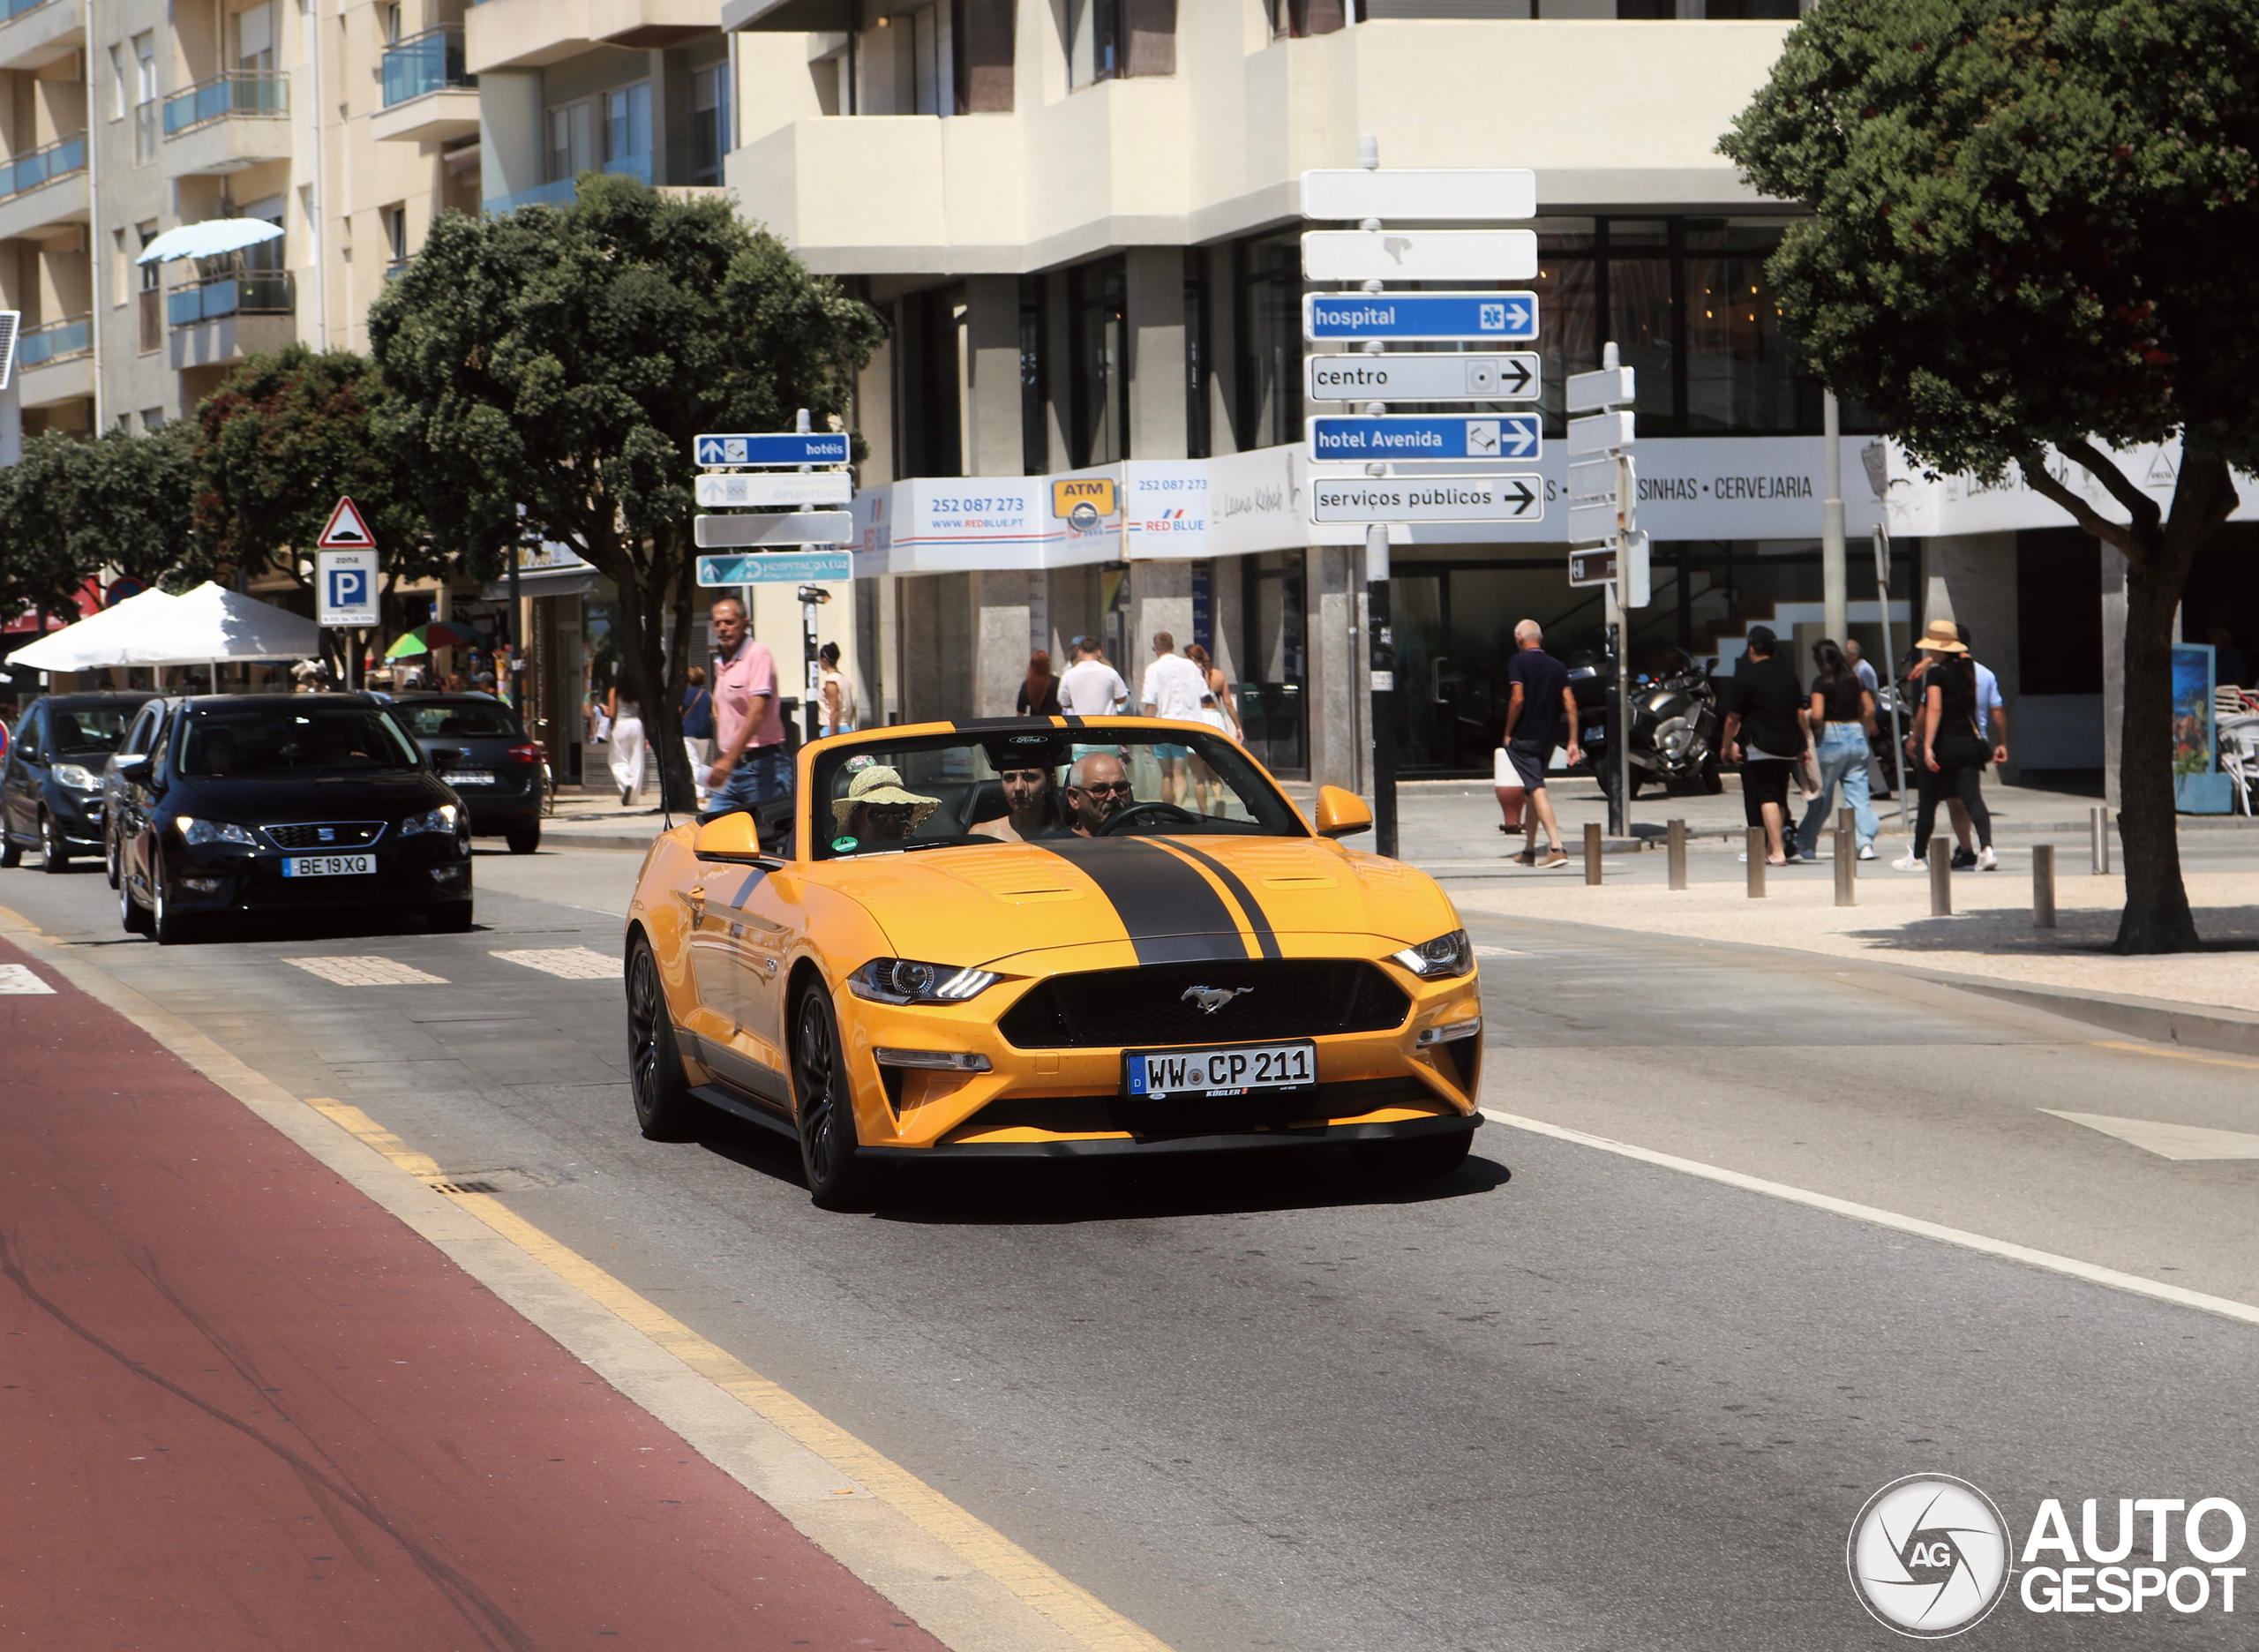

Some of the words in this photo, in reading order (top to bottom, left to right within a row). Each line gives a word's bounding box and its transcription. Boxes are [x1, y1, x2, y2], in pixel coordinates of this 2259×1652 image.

[1315, 306, 1396, 329] hospital
[1317, 368, 1388, 385] centro
[1318, 431, 1367, 447] hotel
[1371, 431, 1443, 447] Avenida
[806, 443, 844, 455] hotéis
[1064, 484, 1103, 496] ATM
[1139, 480, 1160, 490] 252
[1163, 480, 1183, 490] 087
[1188, 479, 1207, 489] 273
[1636, 477, 1697, 500] SINHAS
[1715, 477, 1812, 499] CERVEJARIA
[773, 487, 845, 500] desportivos
[1320, 490, 1401, 510] serviços
[1409, 488, 1491, 508] públicos
[932, 499, 959, 512] 252
[963, 499, 992, 512] 087
[997, 498, 1024, 511] 273
[932, 519, 1024, 528] WWW.REDBLUE.PT
[1146, 521, 1170, 531] RED
[1174, 521, 1204, 530] BLUE
[336, 572, 360, 605] P
[300, 859, 323, 875] BE
[326, 858, 341, 873] 19
[1147, 1057, 1186, 1089] WW
[1208, 1054, 1248, 1085] CP
[1255, 1050, 1310, 1082] 211
[1134, 1078, 1141, 1088] D
